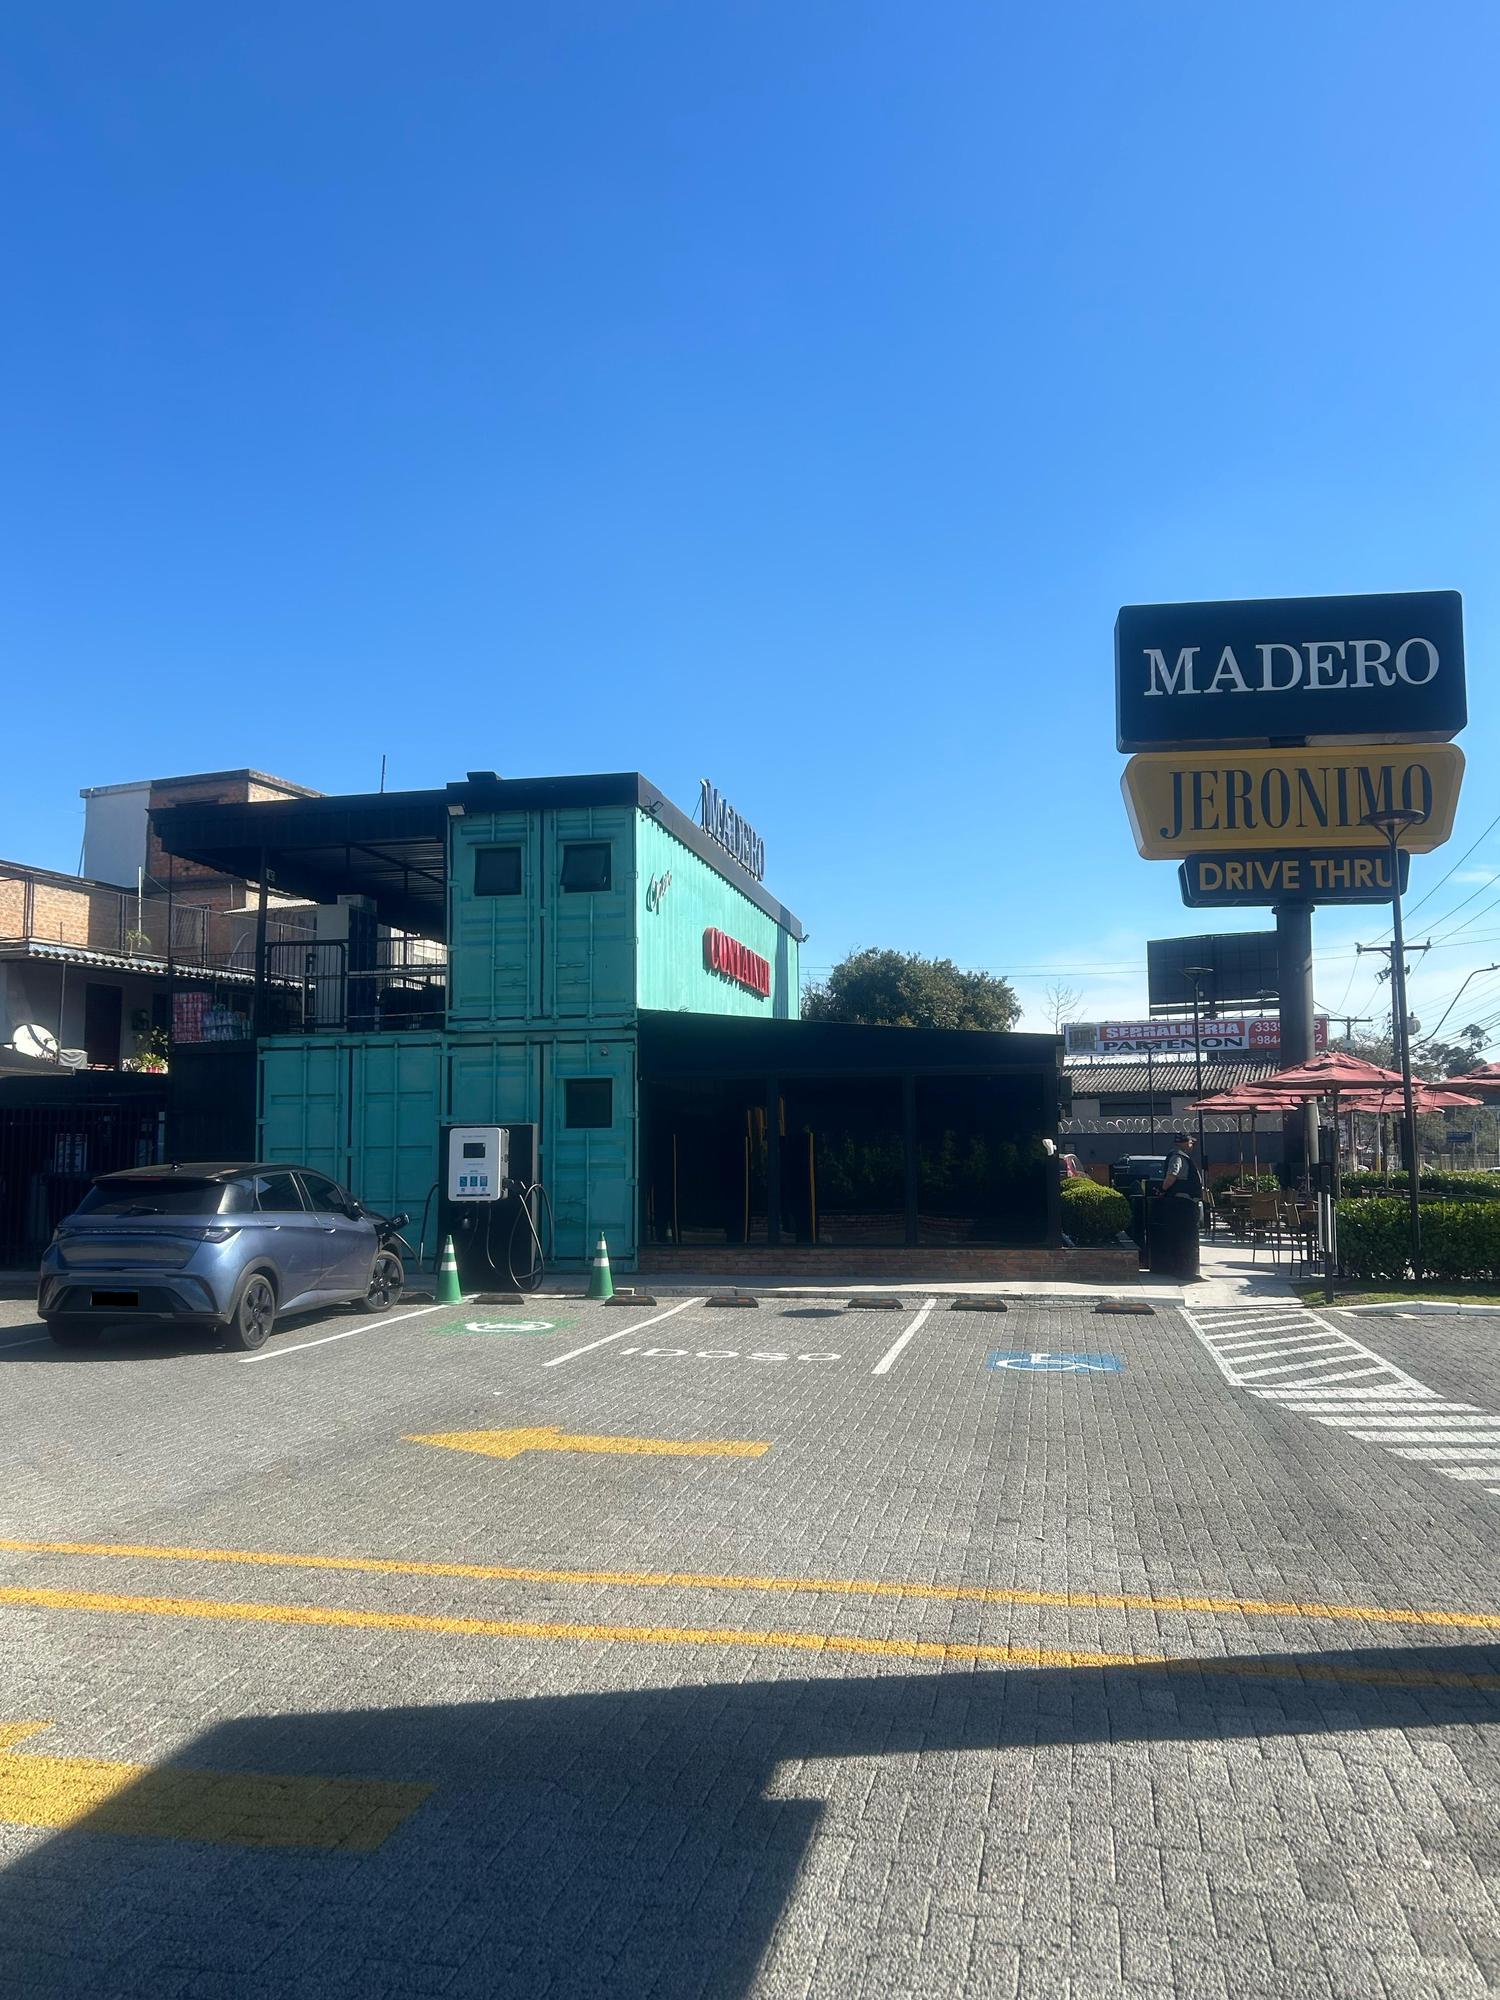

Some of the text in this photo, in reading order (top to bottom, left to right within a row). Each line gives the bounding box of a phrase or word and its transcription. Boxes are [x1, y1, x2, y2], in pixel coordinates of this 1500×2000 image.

[1143, 637, 1440, 696] MADERO
[1159, 764, 1433, 840] JERONIMO
[700, 778, 765, 882] MADERO
[1199, 858, 1394, 891] DRIVE THRU
[1103, 1037, 1243, 1051] PARTENON
[1106, 1022, 1240, 1039] SERRALHERIA
[619, 1347, 842, 1361] IDOSO
